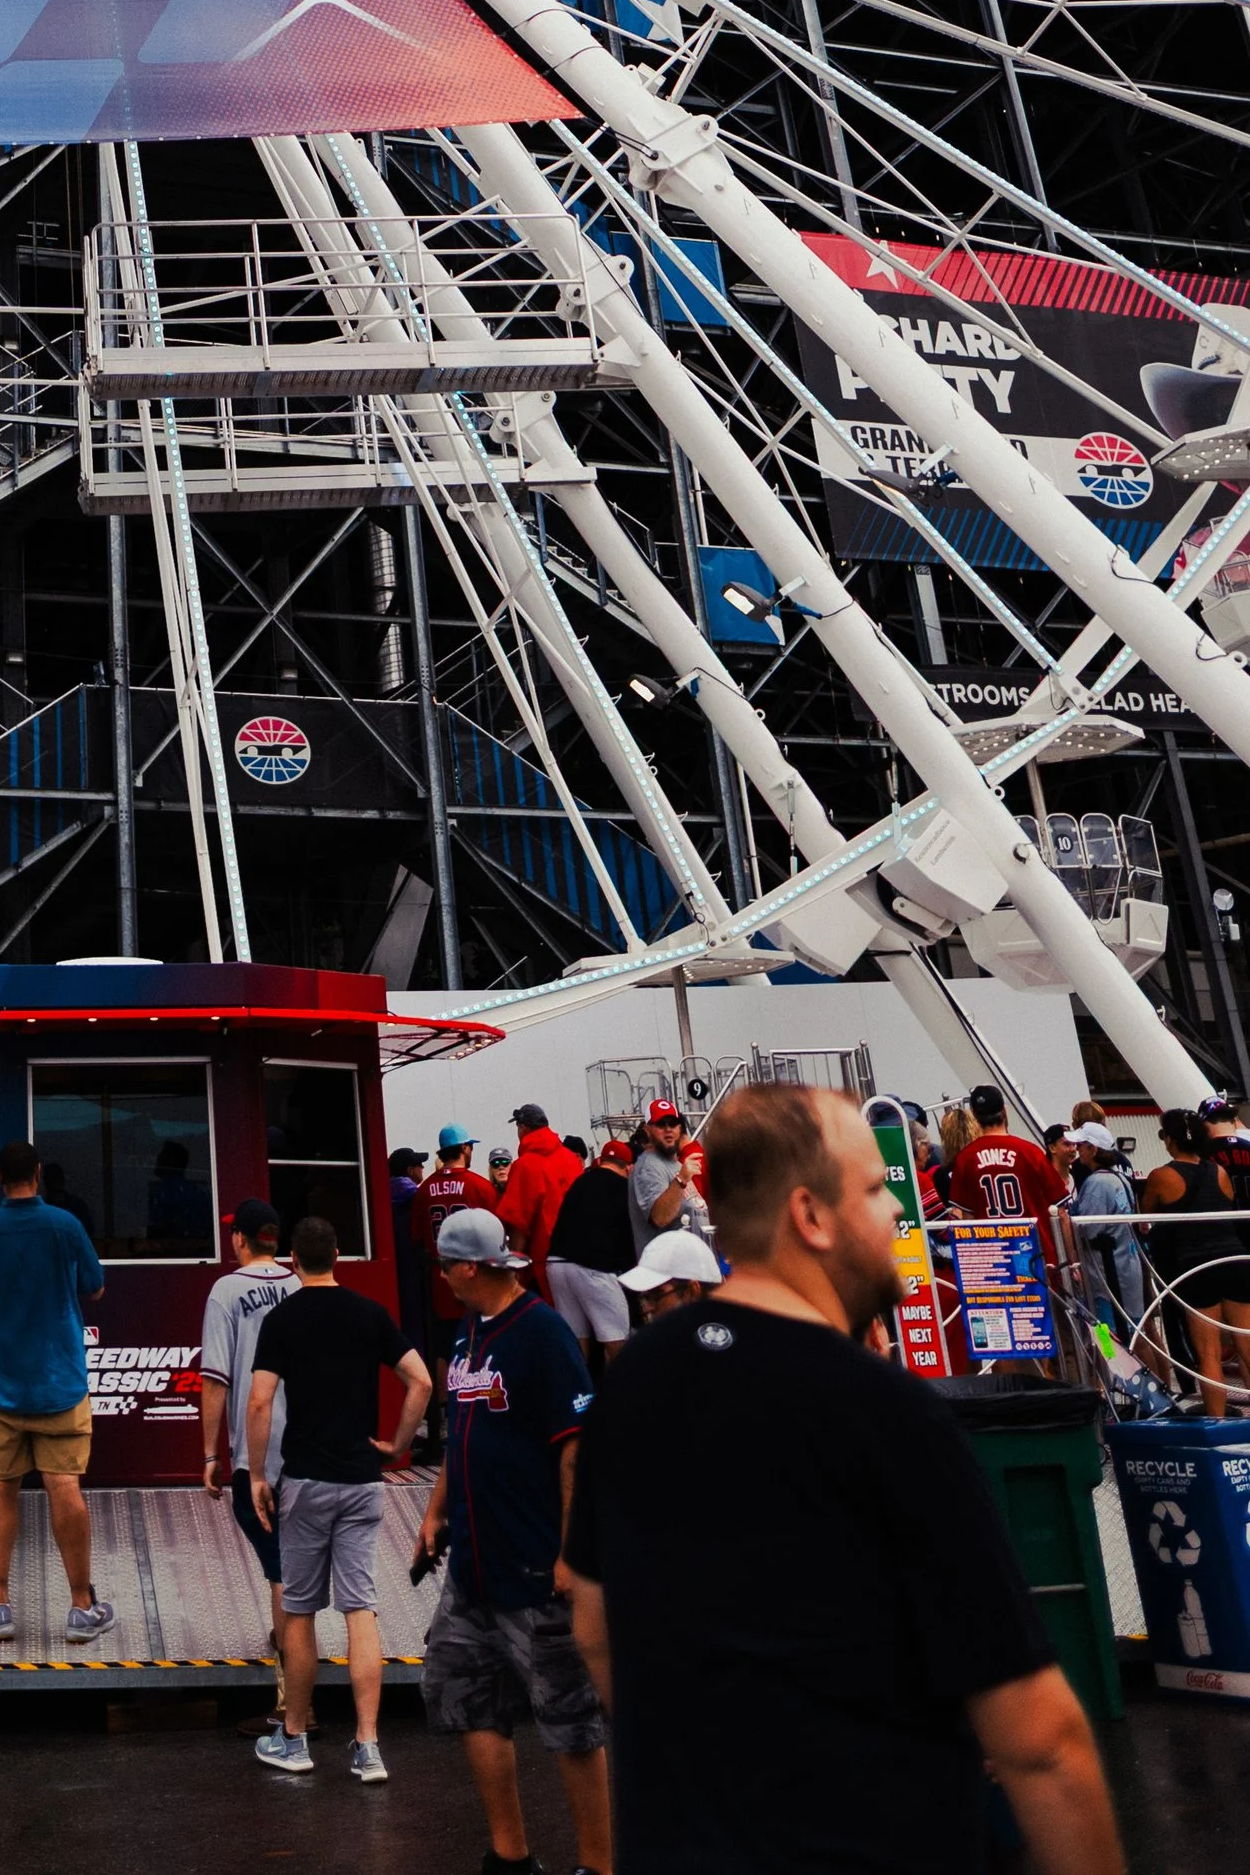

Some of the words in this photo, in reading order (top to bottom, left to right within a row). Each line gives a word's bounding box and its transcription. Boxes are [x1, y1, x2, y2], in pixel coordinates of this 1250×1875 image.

[1057, 836, 1071, 850] 10
[693, 1082, 702, 1095] 9
[977, 1148, 1017, 1169] JONES
[429, 1181, 465, 1197] OLSON
[979, 1173, 1024, 1218] 10
[902, 1305, 932, 1320] MAYBE
[908, 1328, 932, 1343] NEXT
[86, 1347, 202, 1368] EEDWAY
[912, 1351, 938, 1366] YEAR
[86, 1371, 171, 1393] ASSIC
[1125, 1460, 1198, 1477] RECYCLE
